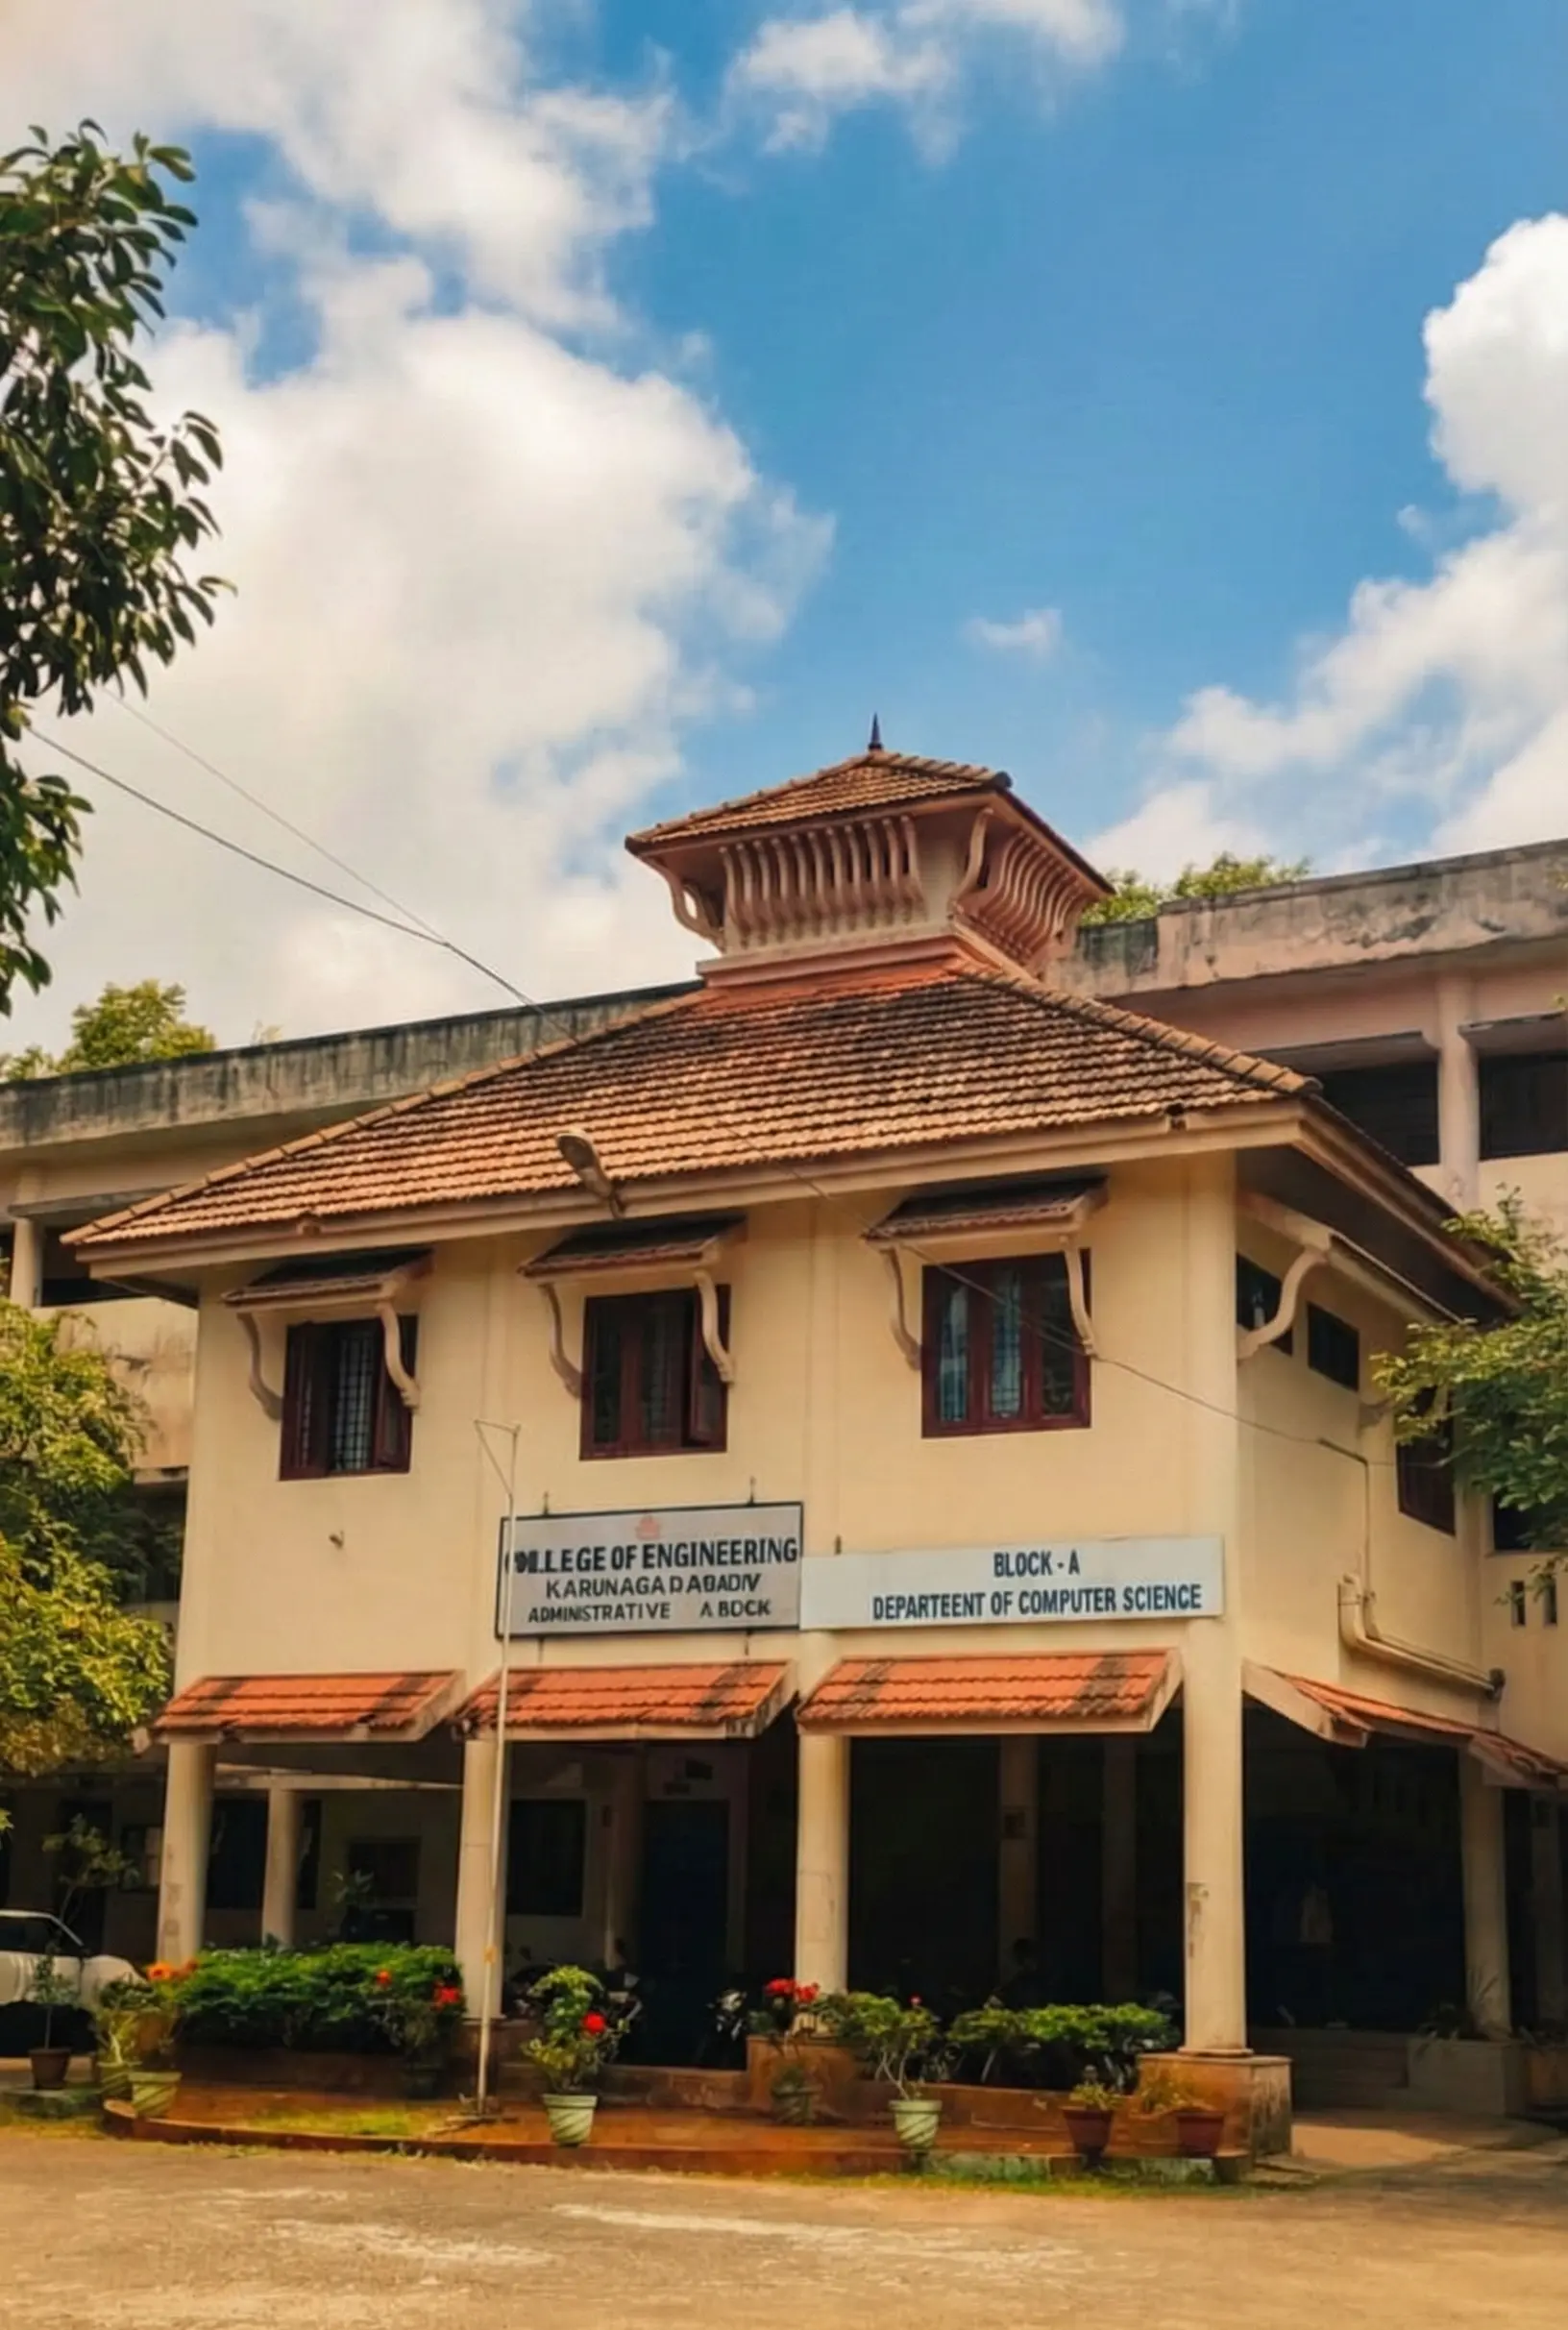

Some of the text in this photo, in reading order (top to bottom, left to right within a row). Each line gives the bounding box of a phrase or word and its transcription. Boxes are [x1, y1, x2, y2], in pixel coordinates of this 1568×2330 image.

[611, 1545, 637, 1570] OF
[643, 1538, 797, 1569] ENGINEERING
[994, 1551, 1052, 1577] BLOCK
[1068, 1550, 1080, 1575] A
[873, 1584, 1201, 1619] DEPARTEENT OF COMPUTER SCIENCE
